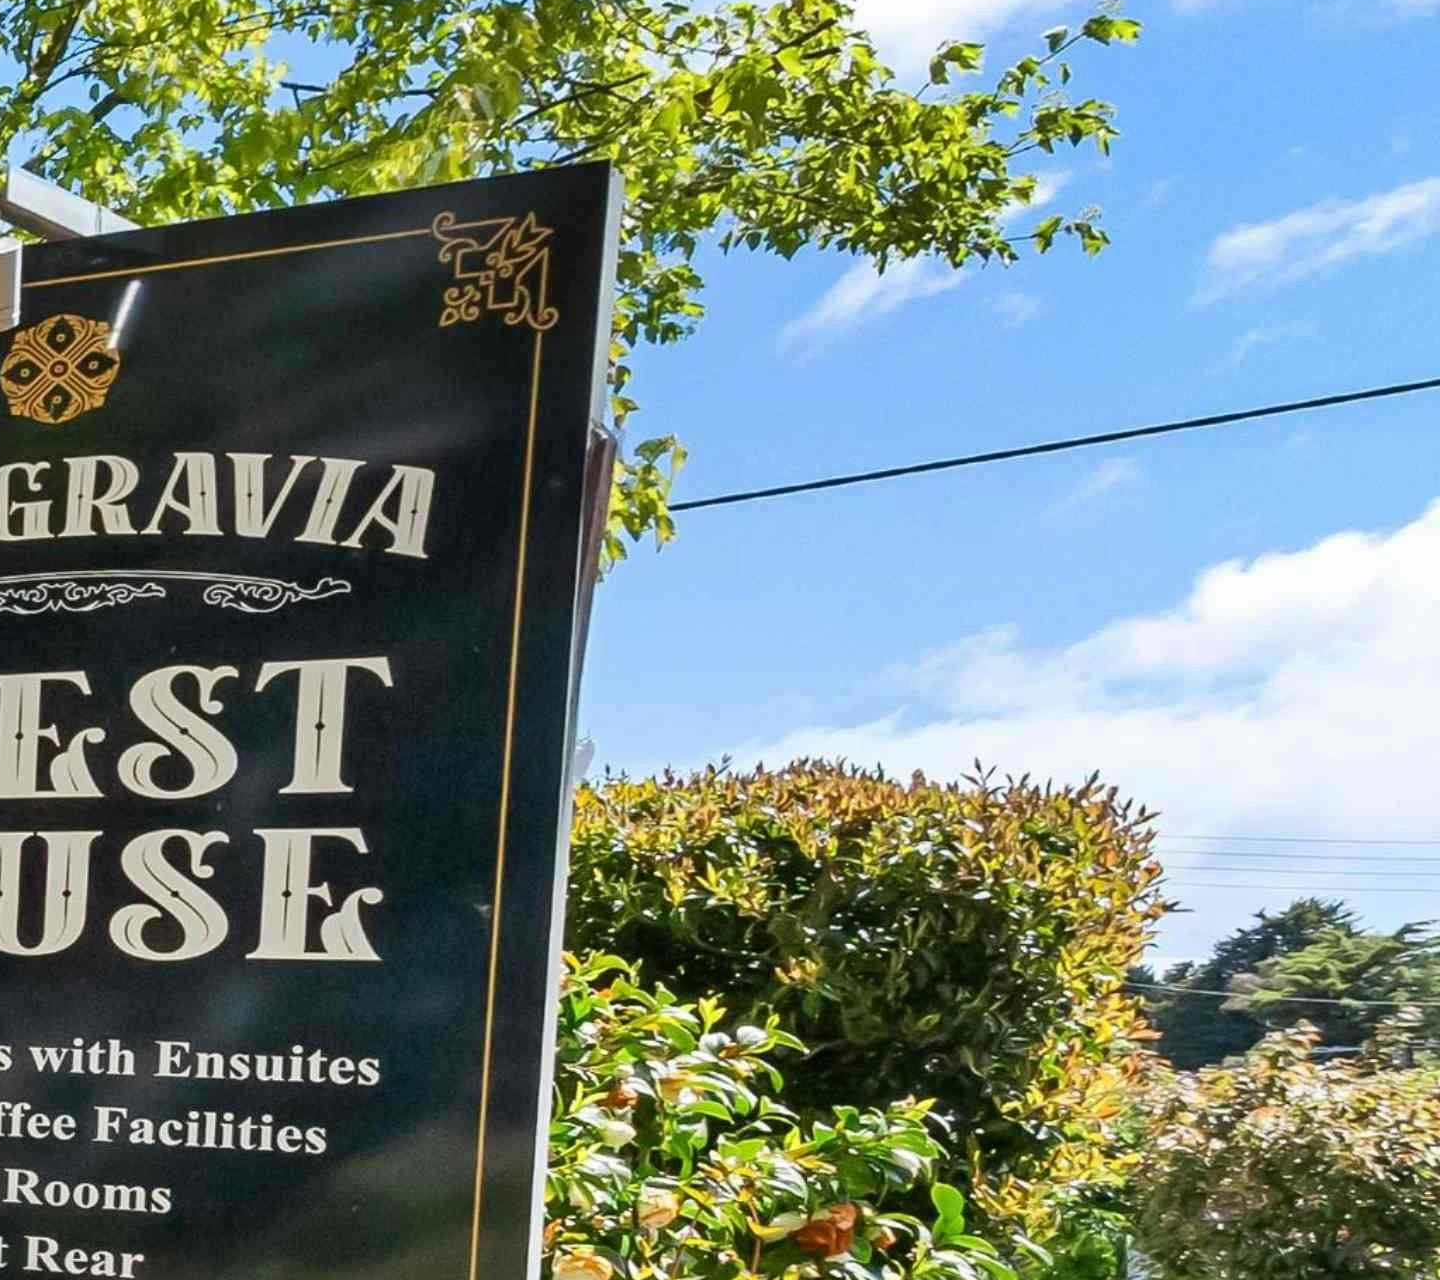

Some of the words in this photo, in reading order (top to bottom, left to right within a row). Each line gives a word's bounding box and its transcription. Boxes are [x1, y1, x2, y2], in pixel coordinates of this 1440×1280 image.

[28, 1037, 136, 1076] with
[153, 1040, 380, 1086] Ensuites
[92, 1105, 327, 1155] Facilities
[2, 1167, 172, 1214] Rooms
[23, 1235, 145, 1279] Rear
